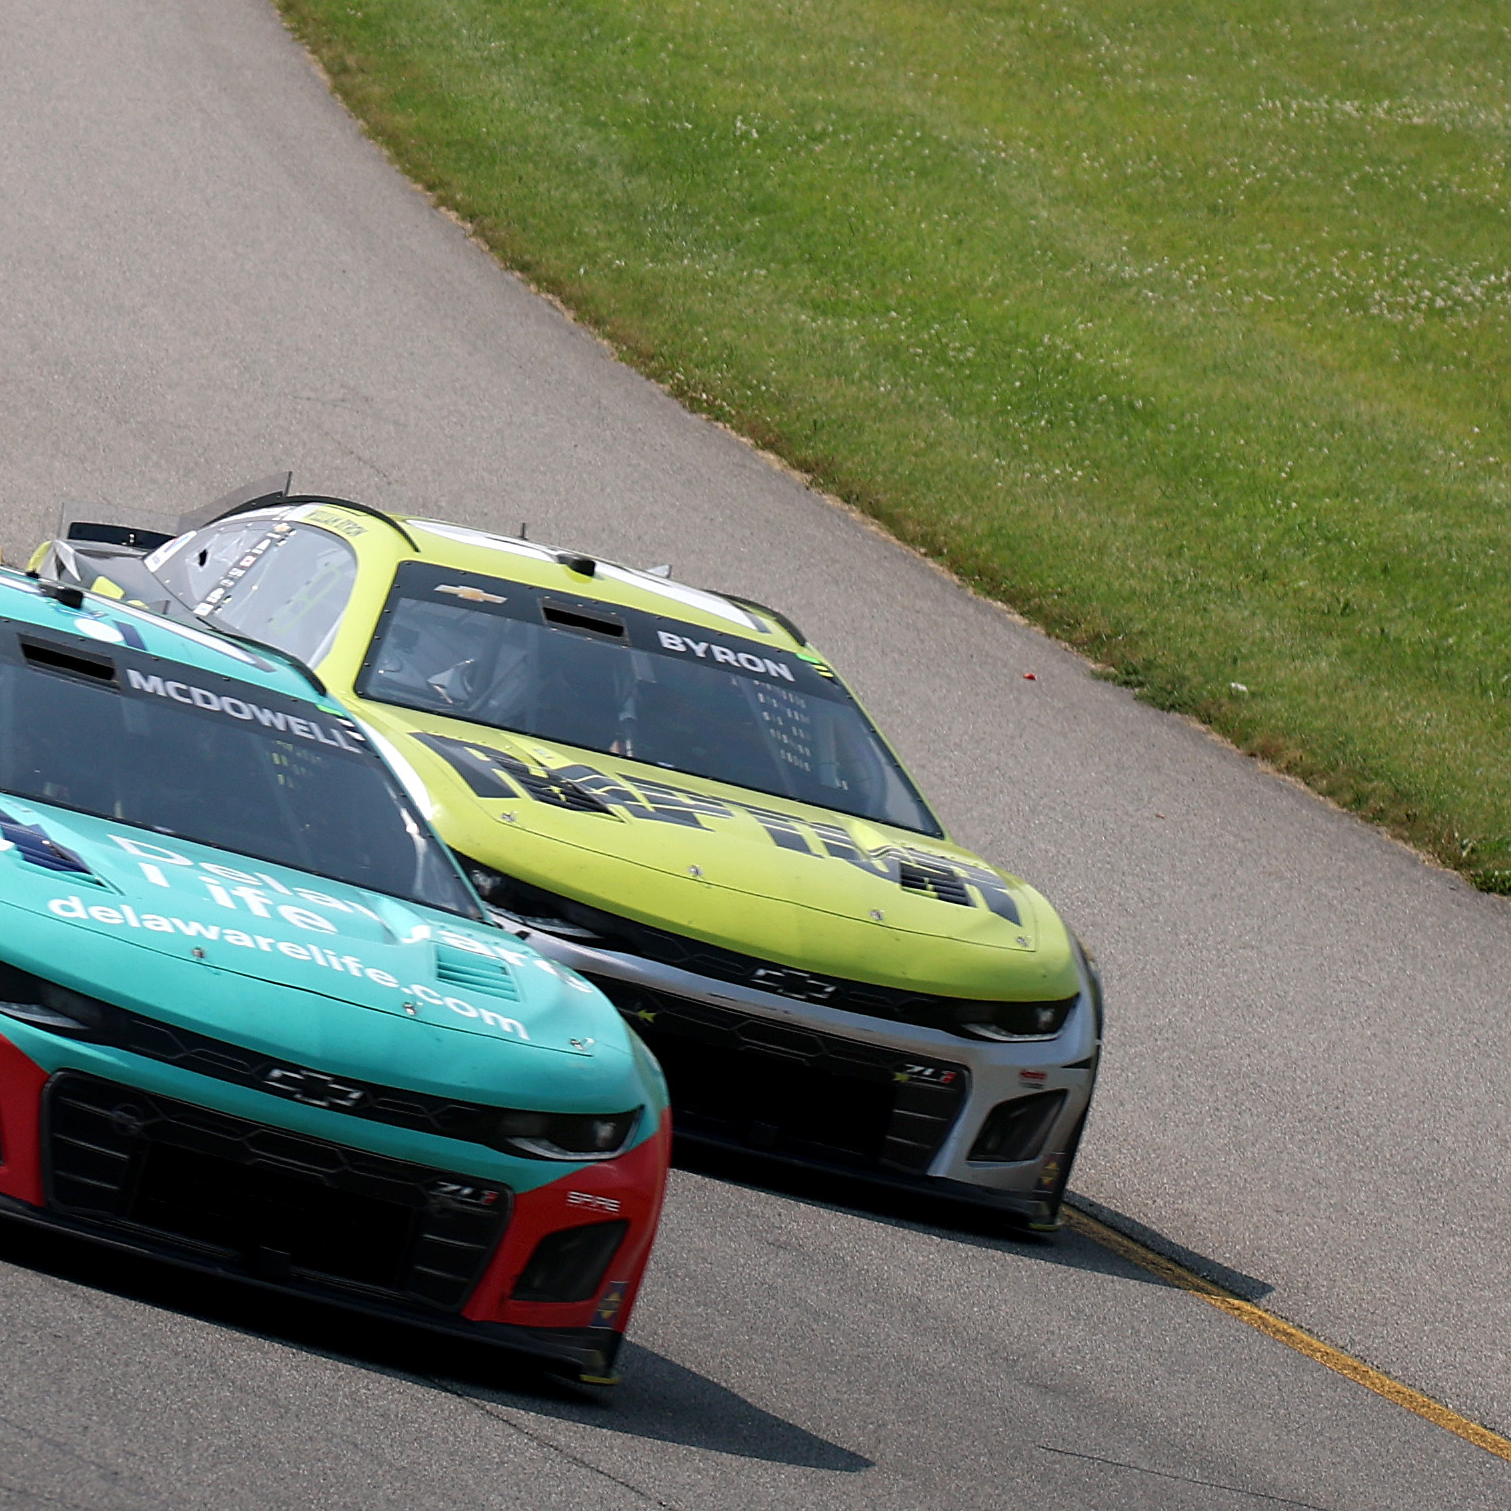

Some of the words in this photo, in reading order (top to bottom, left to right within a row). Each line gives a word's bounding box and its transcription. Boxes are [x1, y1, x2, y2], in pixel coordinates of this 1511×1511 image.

[657, 630, 796, 684] BYRON
[126, 669, 364, 756] MCDOWELL
[48, 895, 532, 1041] delawarelife.com
